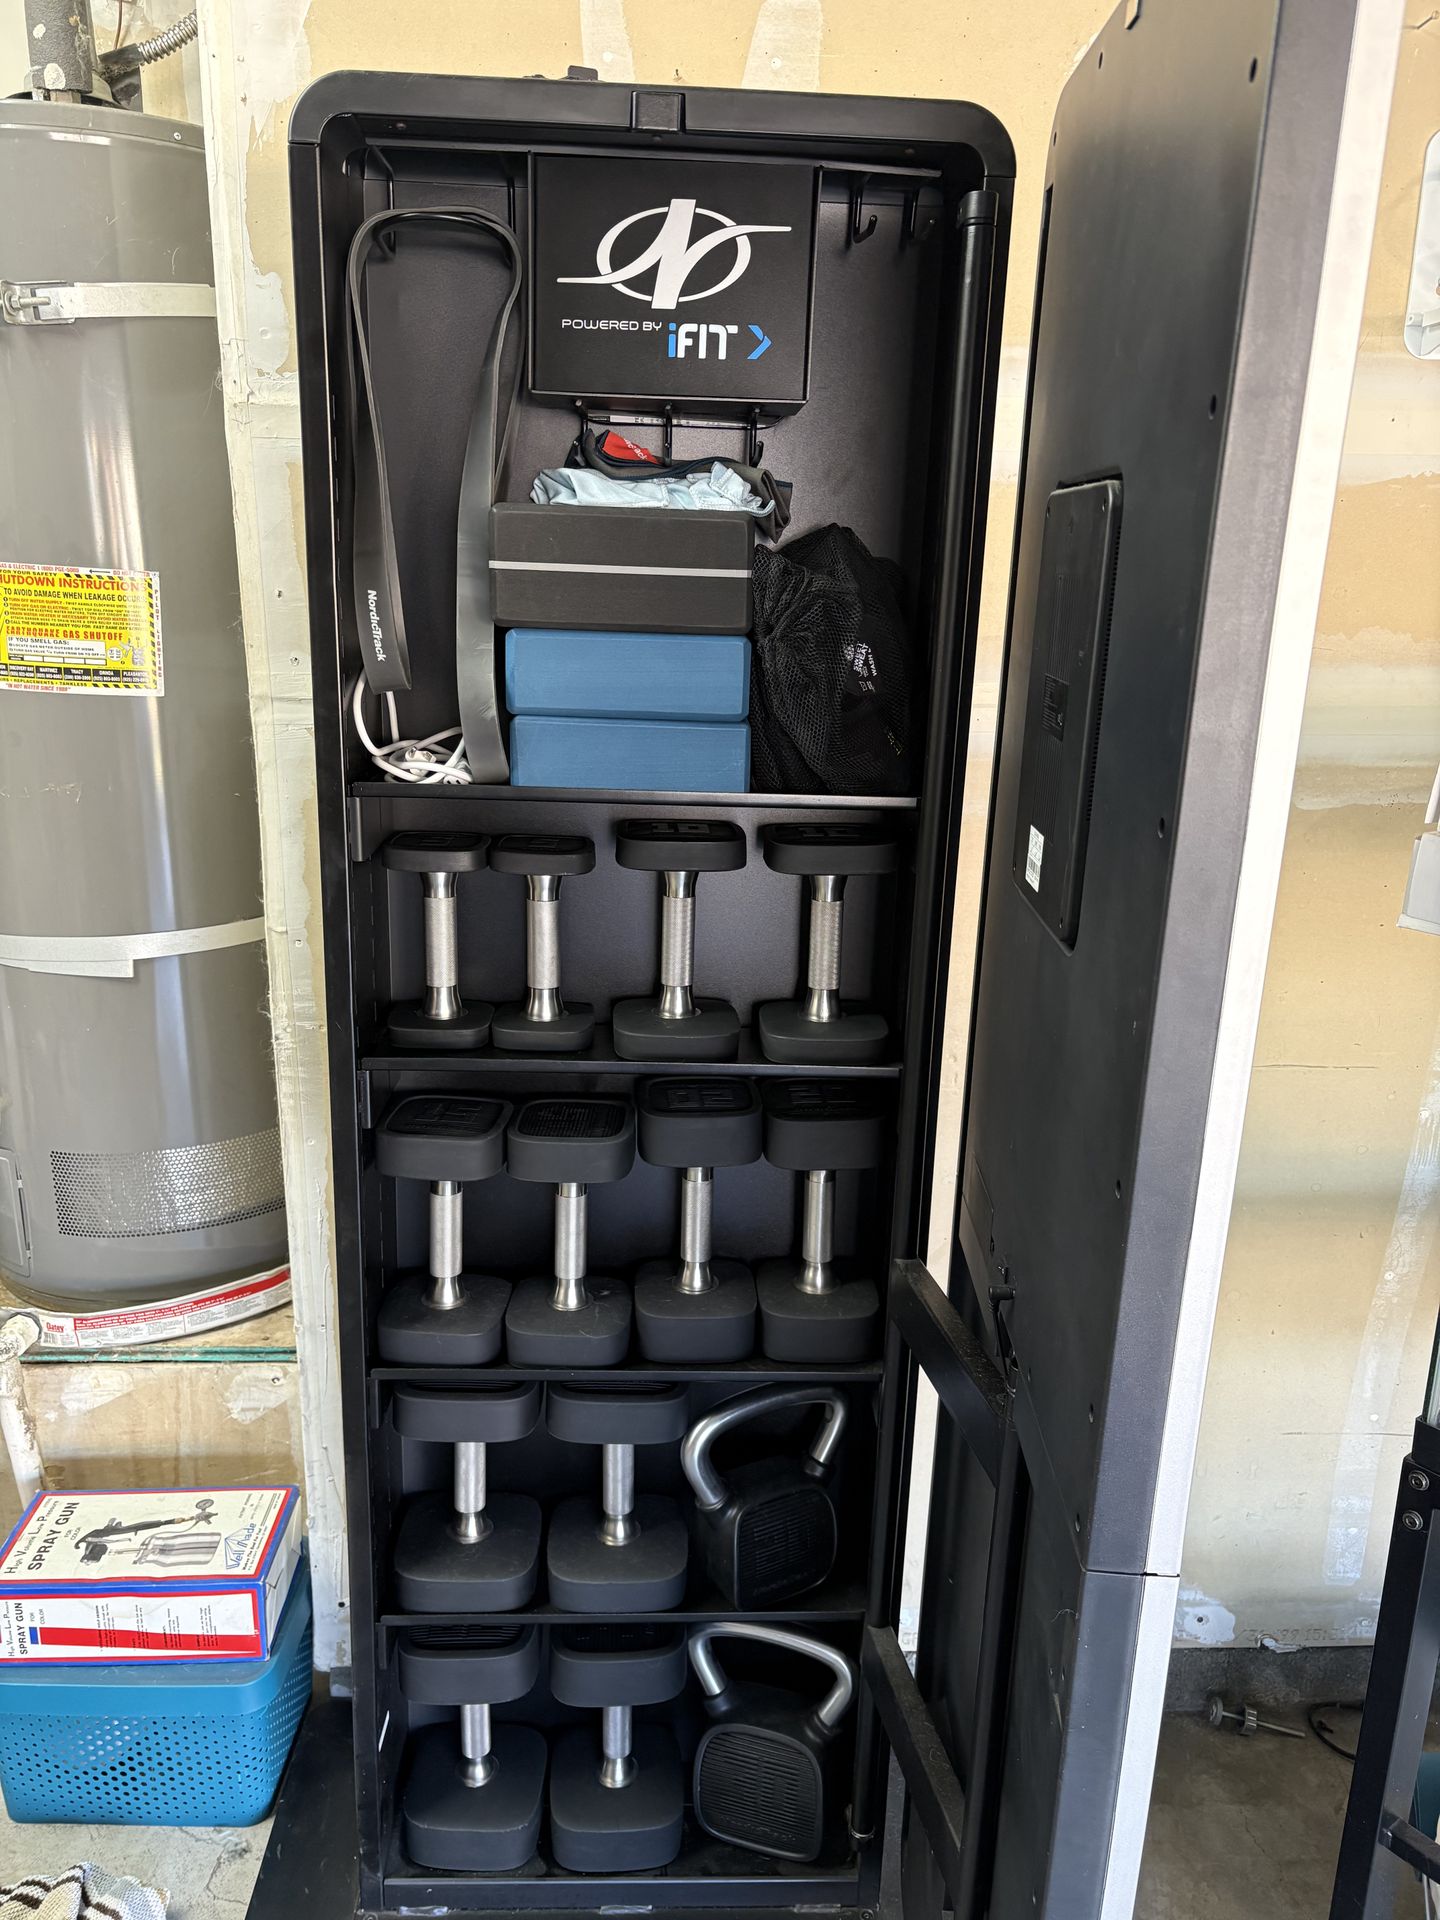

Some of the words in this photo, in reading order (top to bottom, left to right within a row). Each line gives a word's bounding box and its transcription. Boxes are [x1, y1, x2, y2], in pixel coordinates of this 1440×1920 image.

[561, 319, 639, 331] POWERED
[642, 321, 662, 332] BY
[668, 322, 739, 360] iFIT
[4, 587, 11, 595] TO
[14, 588, 32, 596] AVOID
[34, 589, 60, 598] DAMAGE
[62, 591, 82, 599] WHEN
[84, 592, 115, 601] LEAKAGE
[6, 626, 59, 637] EARTHQUAKE
[62, 629, 80, 638] GAS
[83, 630, 122, 641] SHUTOFF
[368, 590, 386, 662] NordicTrack
[868, 654, 878, 676] WASH
[46, 1322, 64, 1333] Oatey
[28, 1530, 61, 1570] SPRAY
[55, 1502, 80, 1525] GUN
[4, 1558, 23, 1574] High
[14, 1603, 24, 1622] GUN
[17, 1626, 28, 1654] SPRAY
